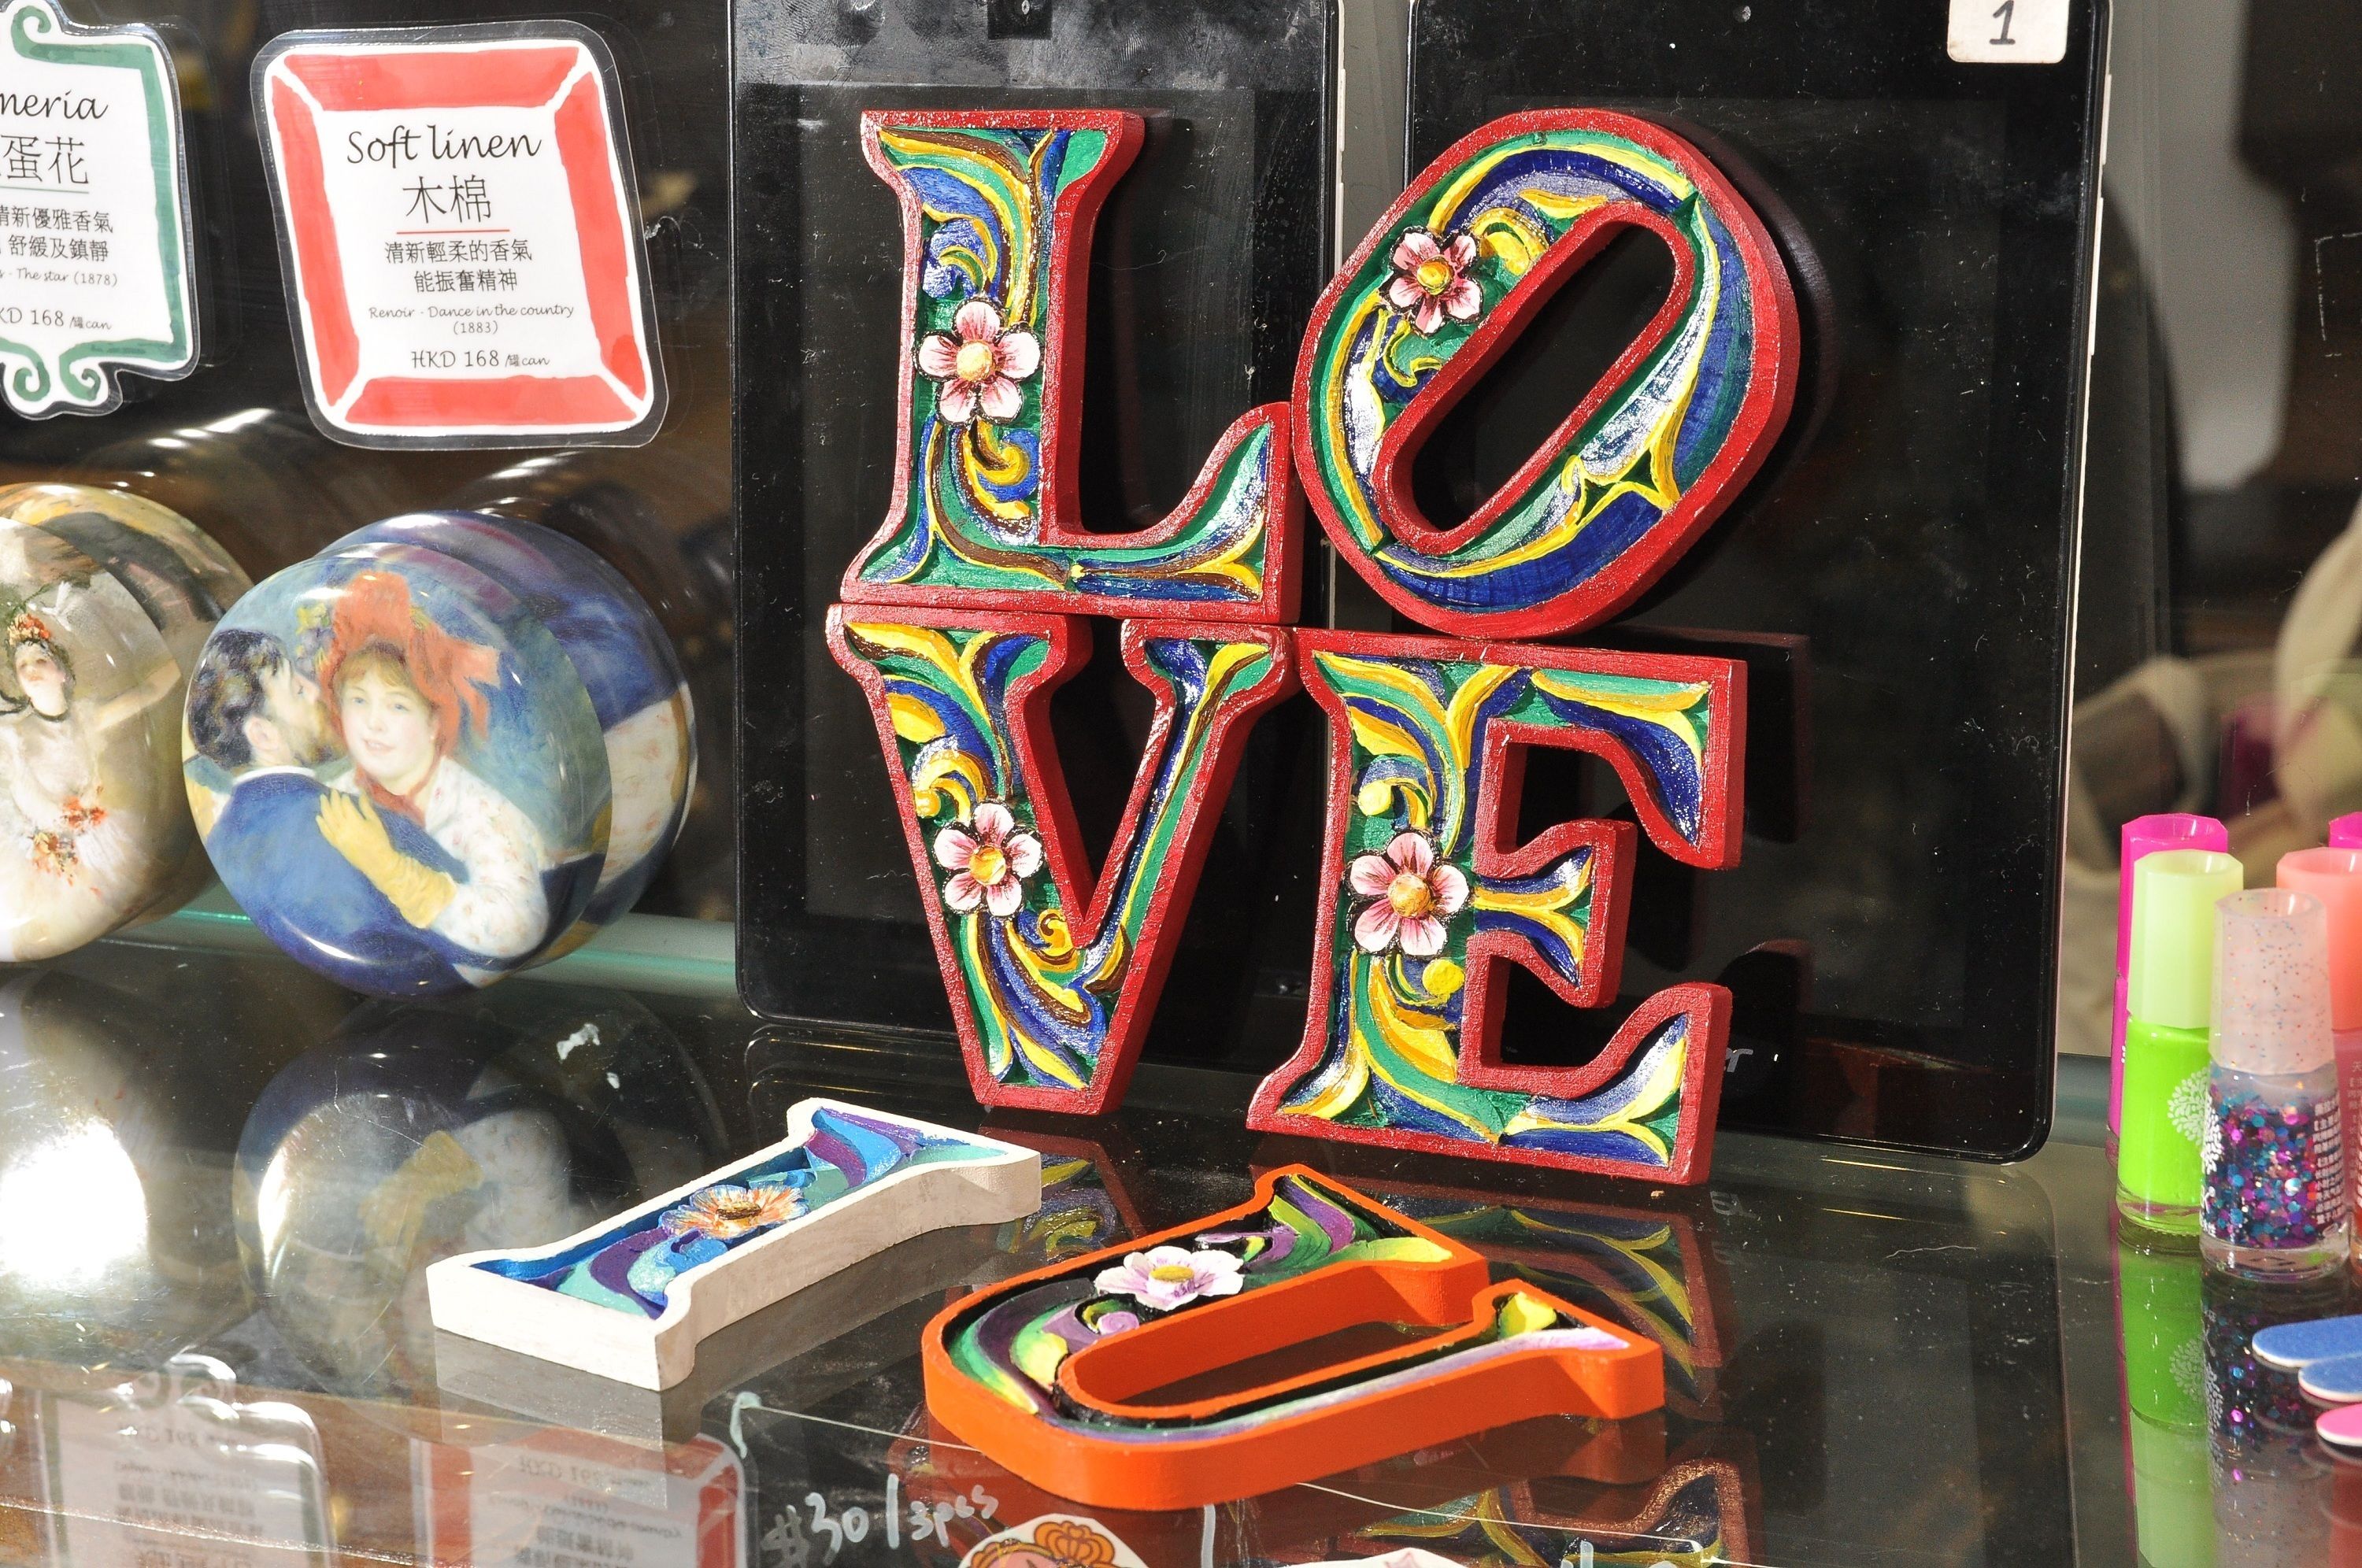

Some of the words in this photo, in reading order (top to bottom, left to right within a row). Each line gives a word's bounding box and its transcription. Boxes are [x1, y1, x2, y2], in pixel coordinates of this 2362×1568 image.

[1989, 0, 2016, 46] 1
[347, 125, 421, 168] Soft
[427, 124, 542, 160] linen
[0, 134, 89, 184] 蛋花
[402, 174, 492, 224] 木棉
[9, 235, 109, 261] 舒緩及鎮靜
[384, 239, 533, 264] 清新輕柔的香氣
[17, 267, 41, 281] The
[44, 270, 68, 282] star
[74, 271, 118, 287] (1878)
[414, 268, 518, 293] 能振奮精神
[31, 309, 65, 327] 168
[368, 306, 415, 319] Renoir
[428, 305, 474, 317] Dance
[476, 305, 493, 316] in
[495, 304, 518, 316] the
[520, 304, 574, 318] country
[453, 320, 499, 335] (1883)
[411, 349, 457, 368] HKD
[464, 349, 500, 368] 168
